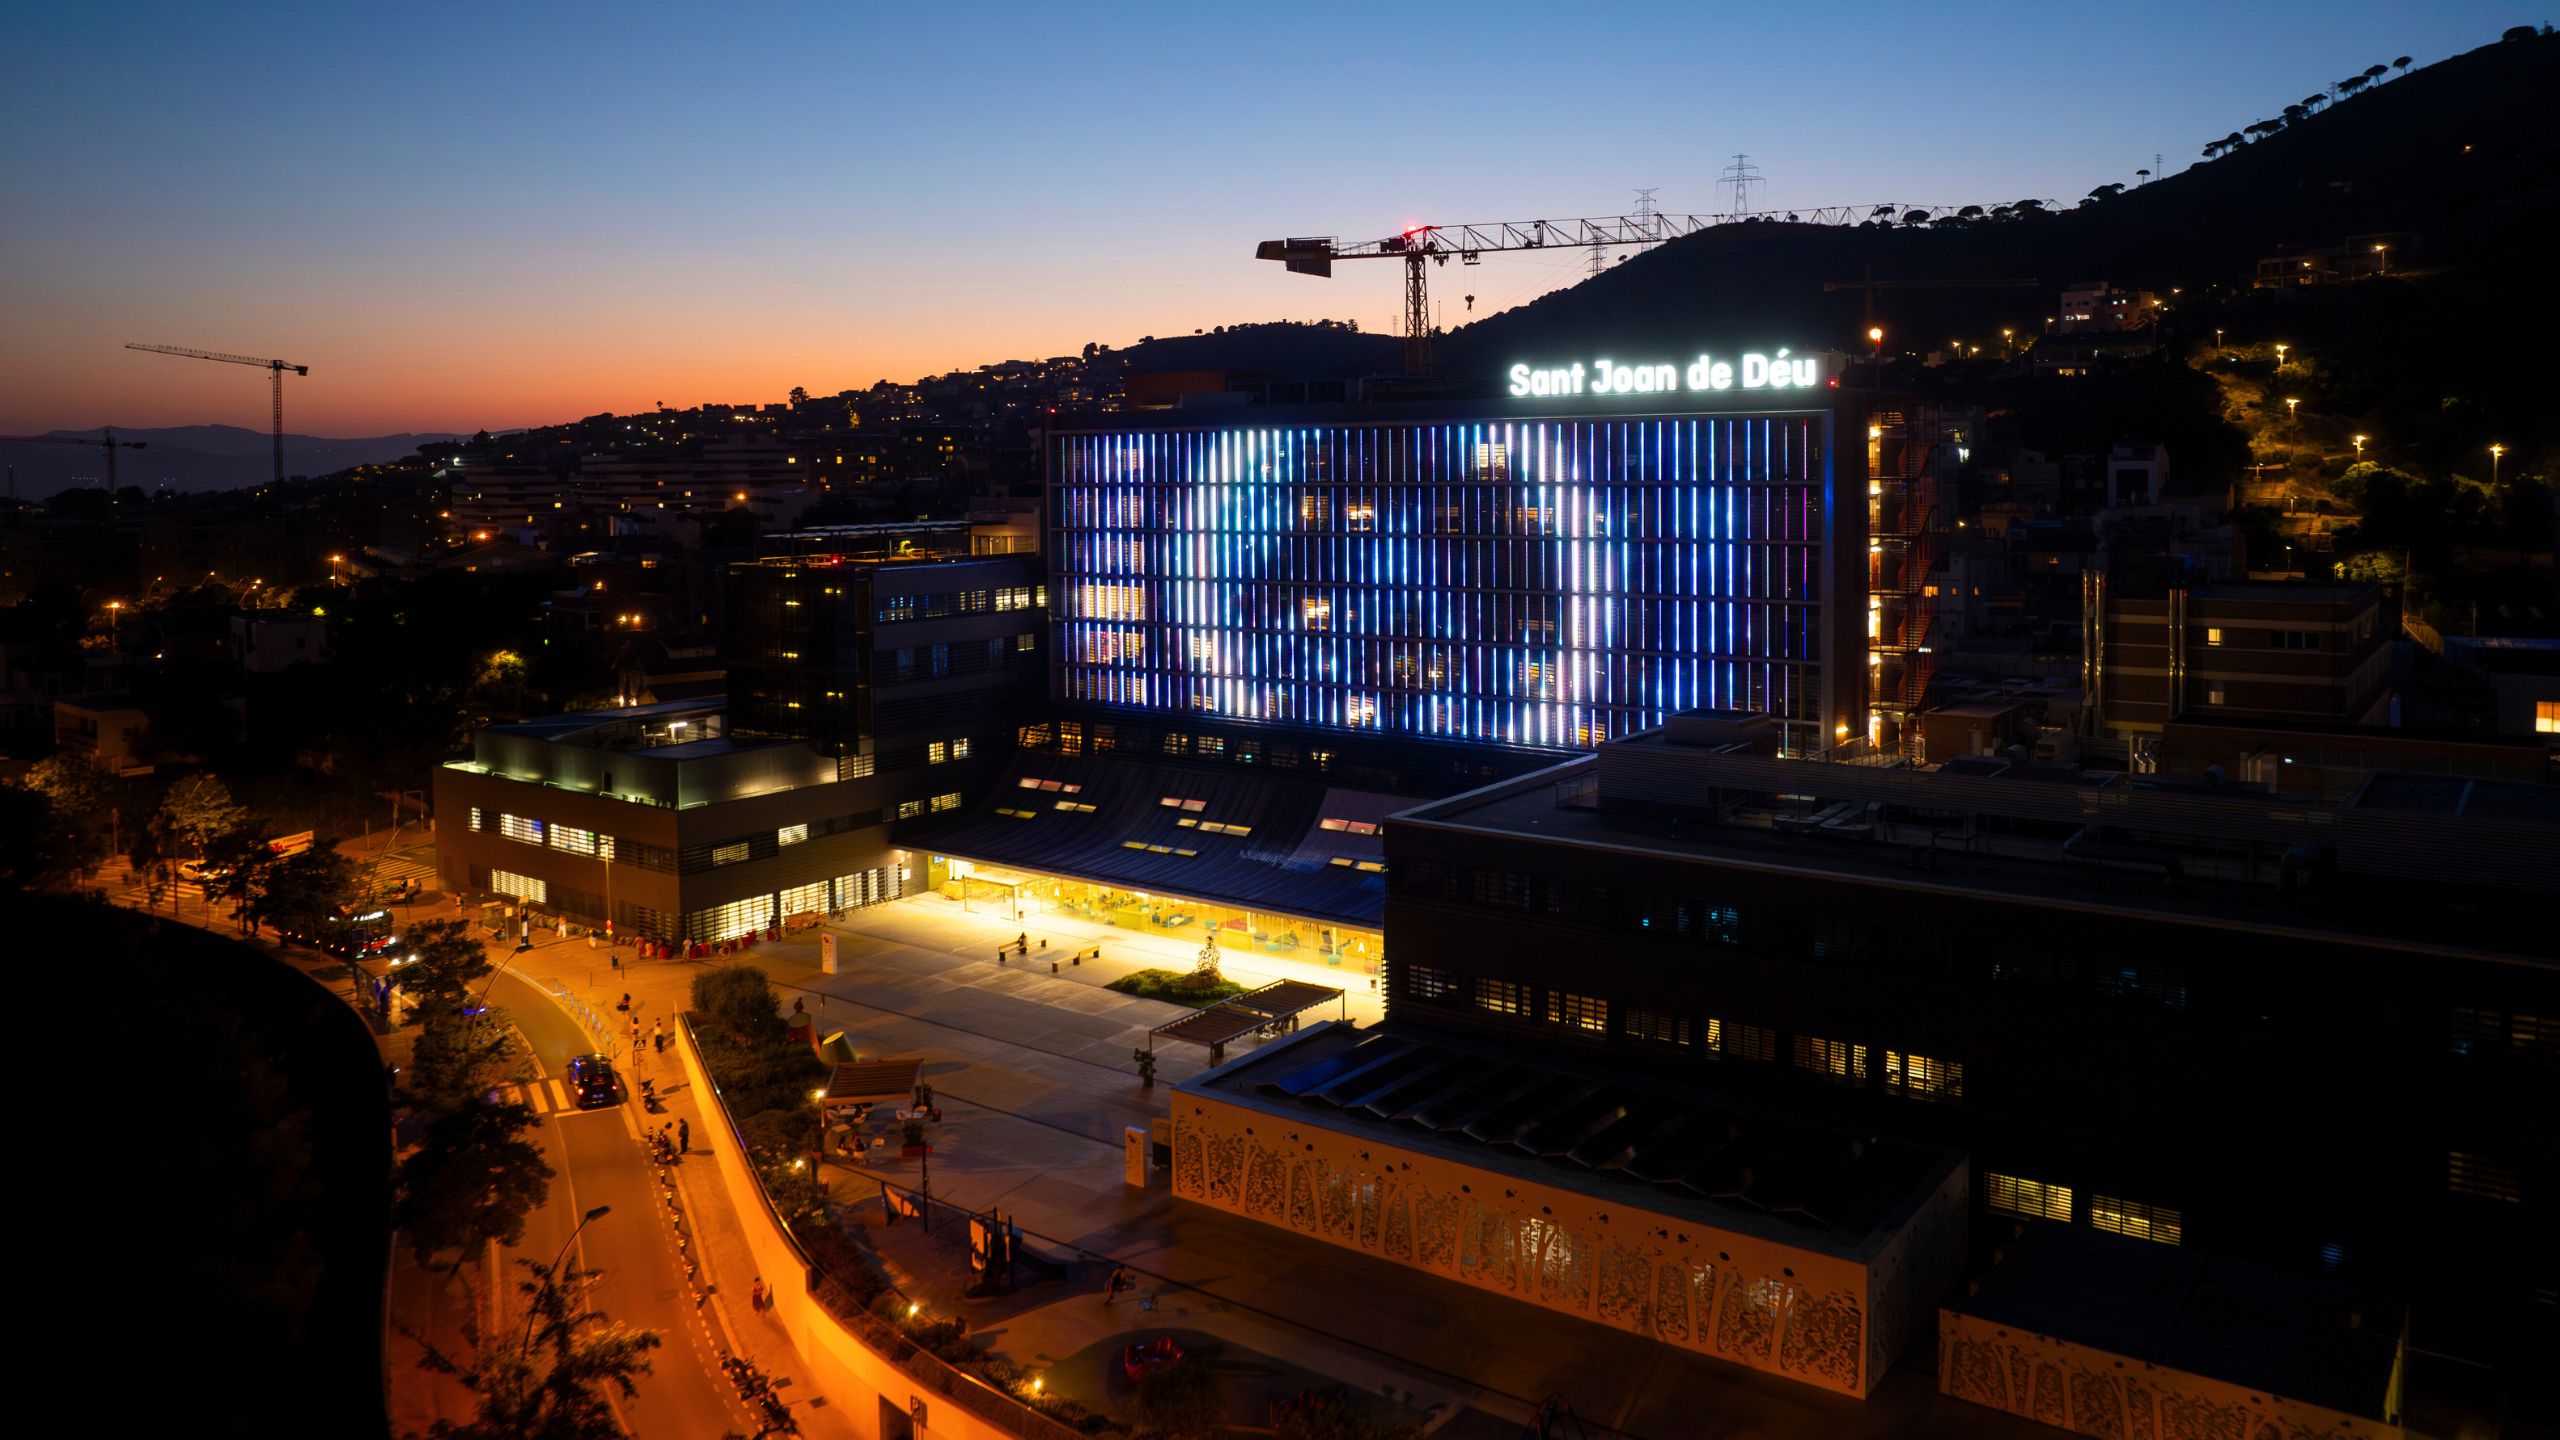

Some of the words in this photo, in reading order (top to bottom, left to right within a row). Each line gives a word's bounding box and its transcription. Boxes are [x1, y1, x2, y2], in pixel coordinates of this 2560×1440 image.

[1510, 363, 1585, 397] Sant
[1592, 360, 1677, 393] Joan
[1687, 355, 1733, 390] de
[1743, 348, 1816, 388] Déu
[1357, 941, 1366, 954] A
